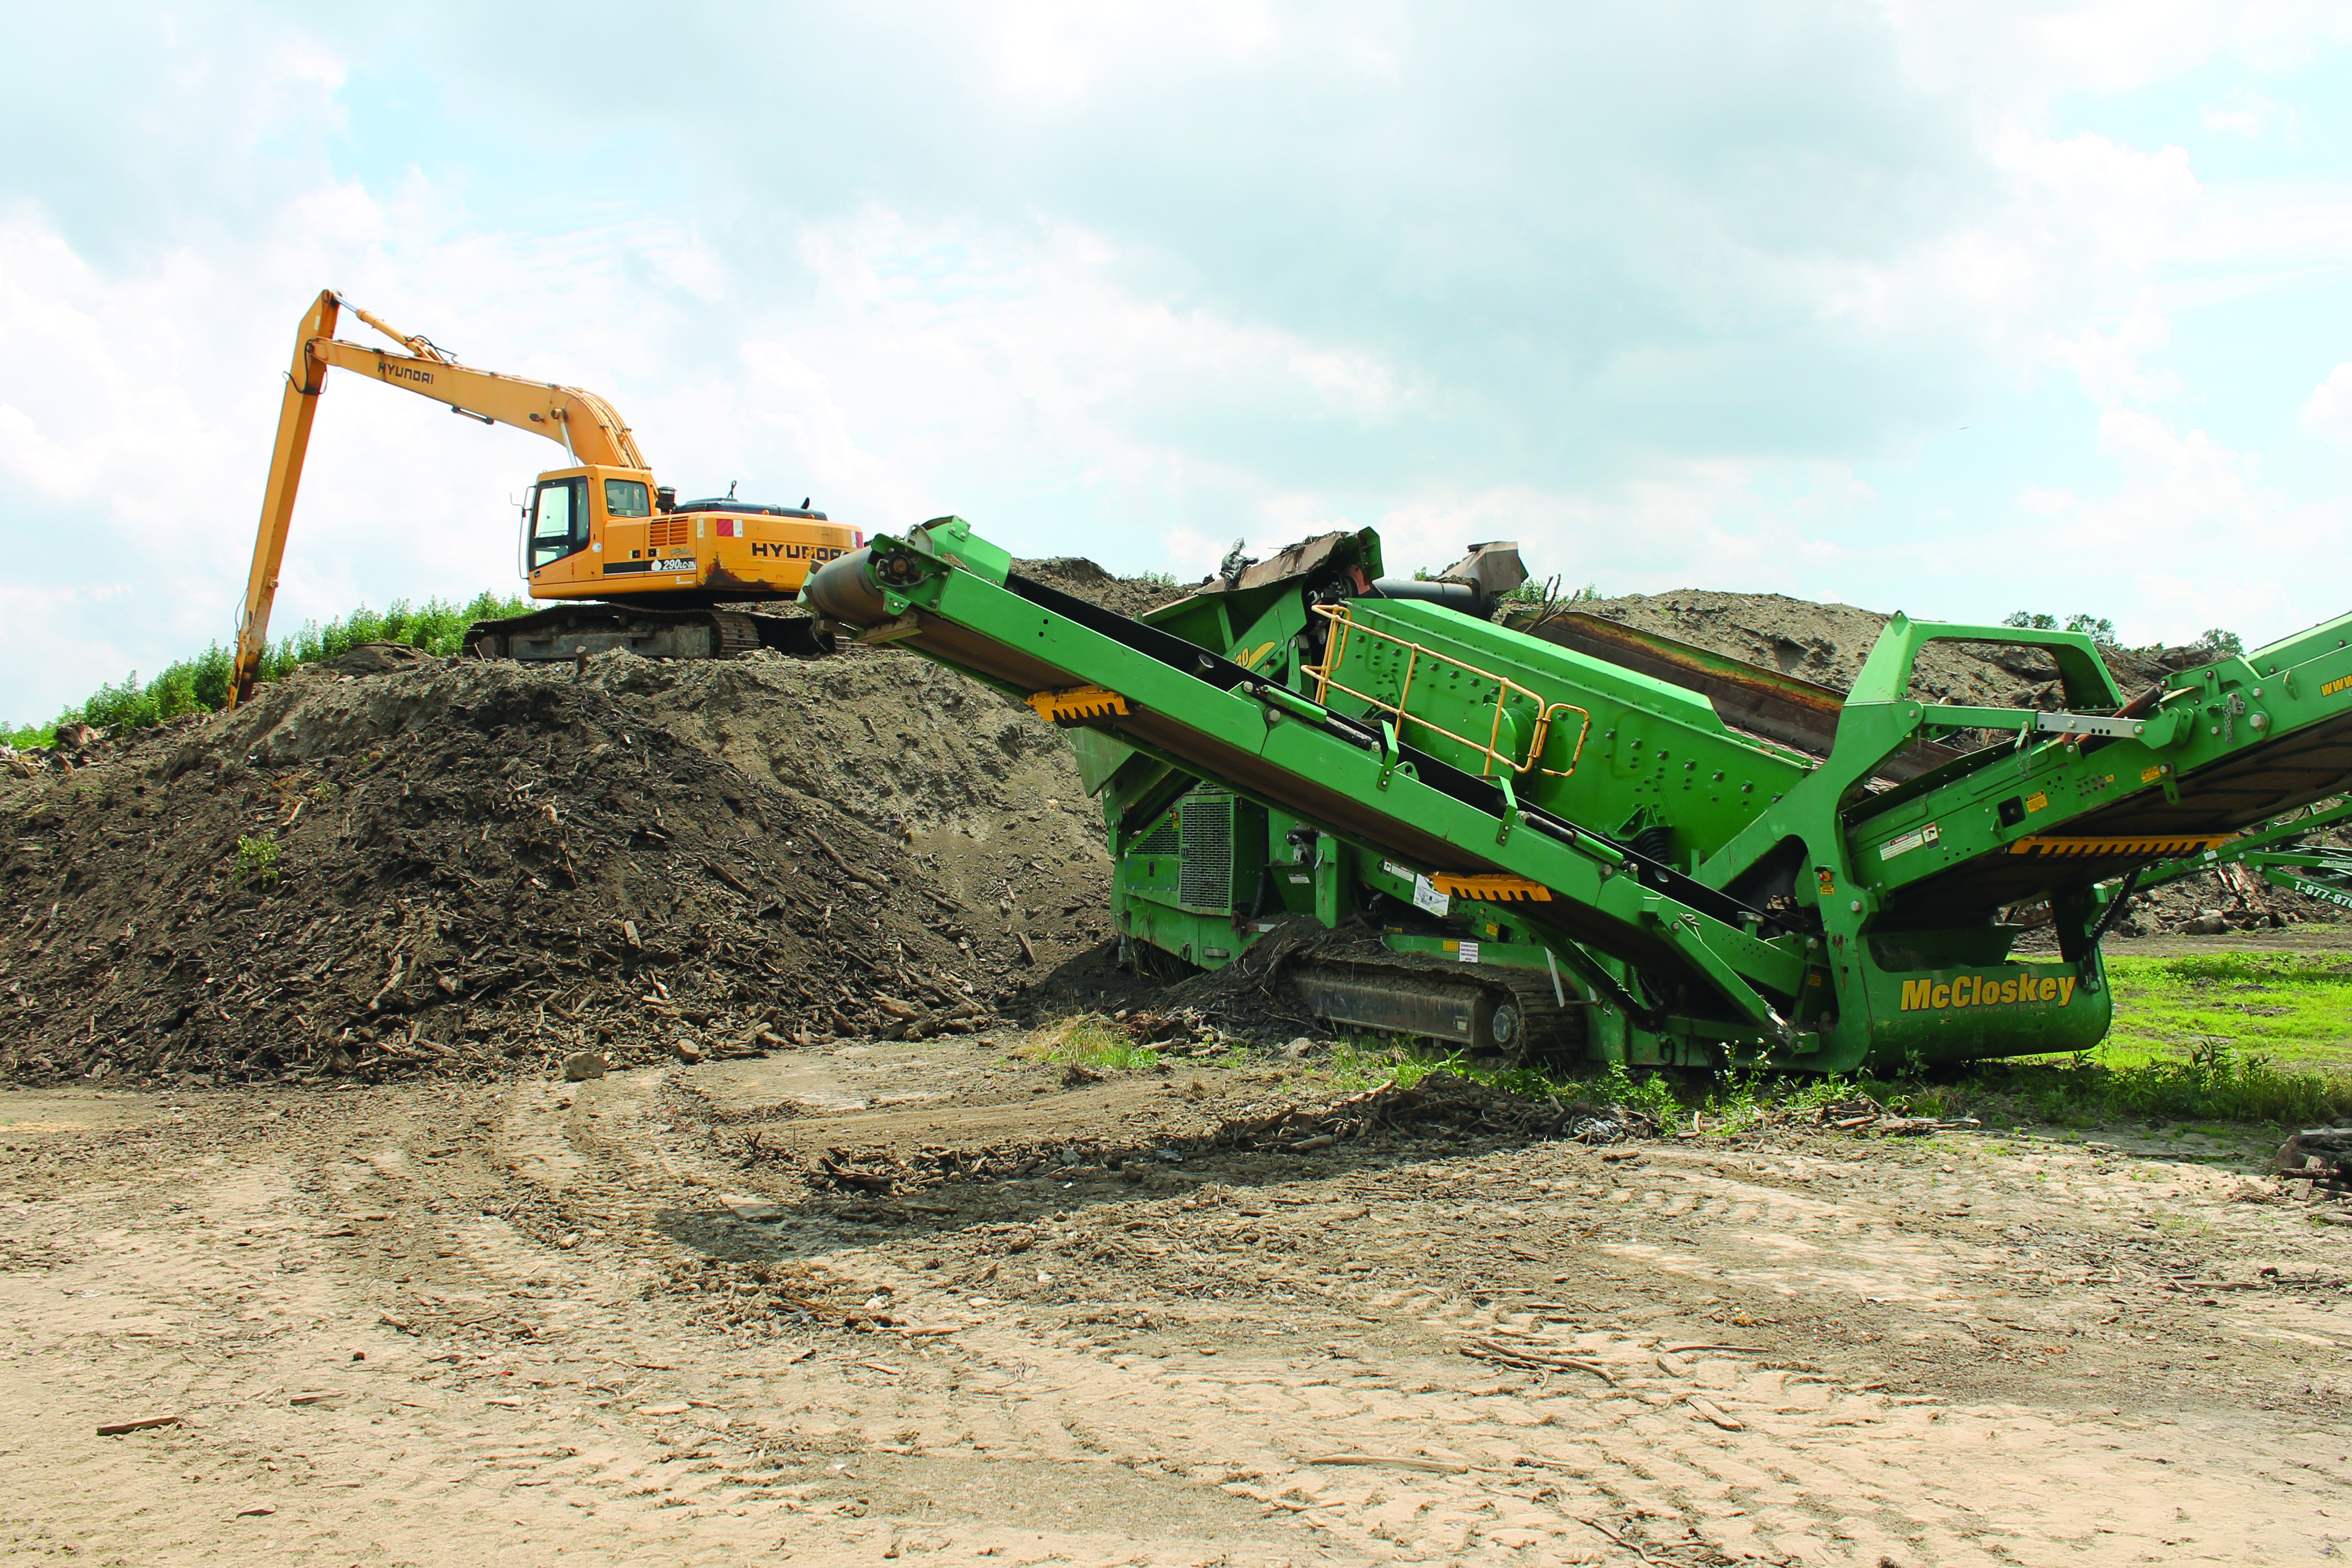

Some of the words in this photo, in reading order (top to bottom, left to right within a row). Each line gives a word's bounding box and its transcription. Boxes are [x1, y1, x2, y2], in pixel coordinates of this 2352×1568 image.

[377, 362, 434, 384] HYUNDAI
[752, 542, 841, 560] HYUNDA
[1900, 973, 2077, 1011] McCloskey
